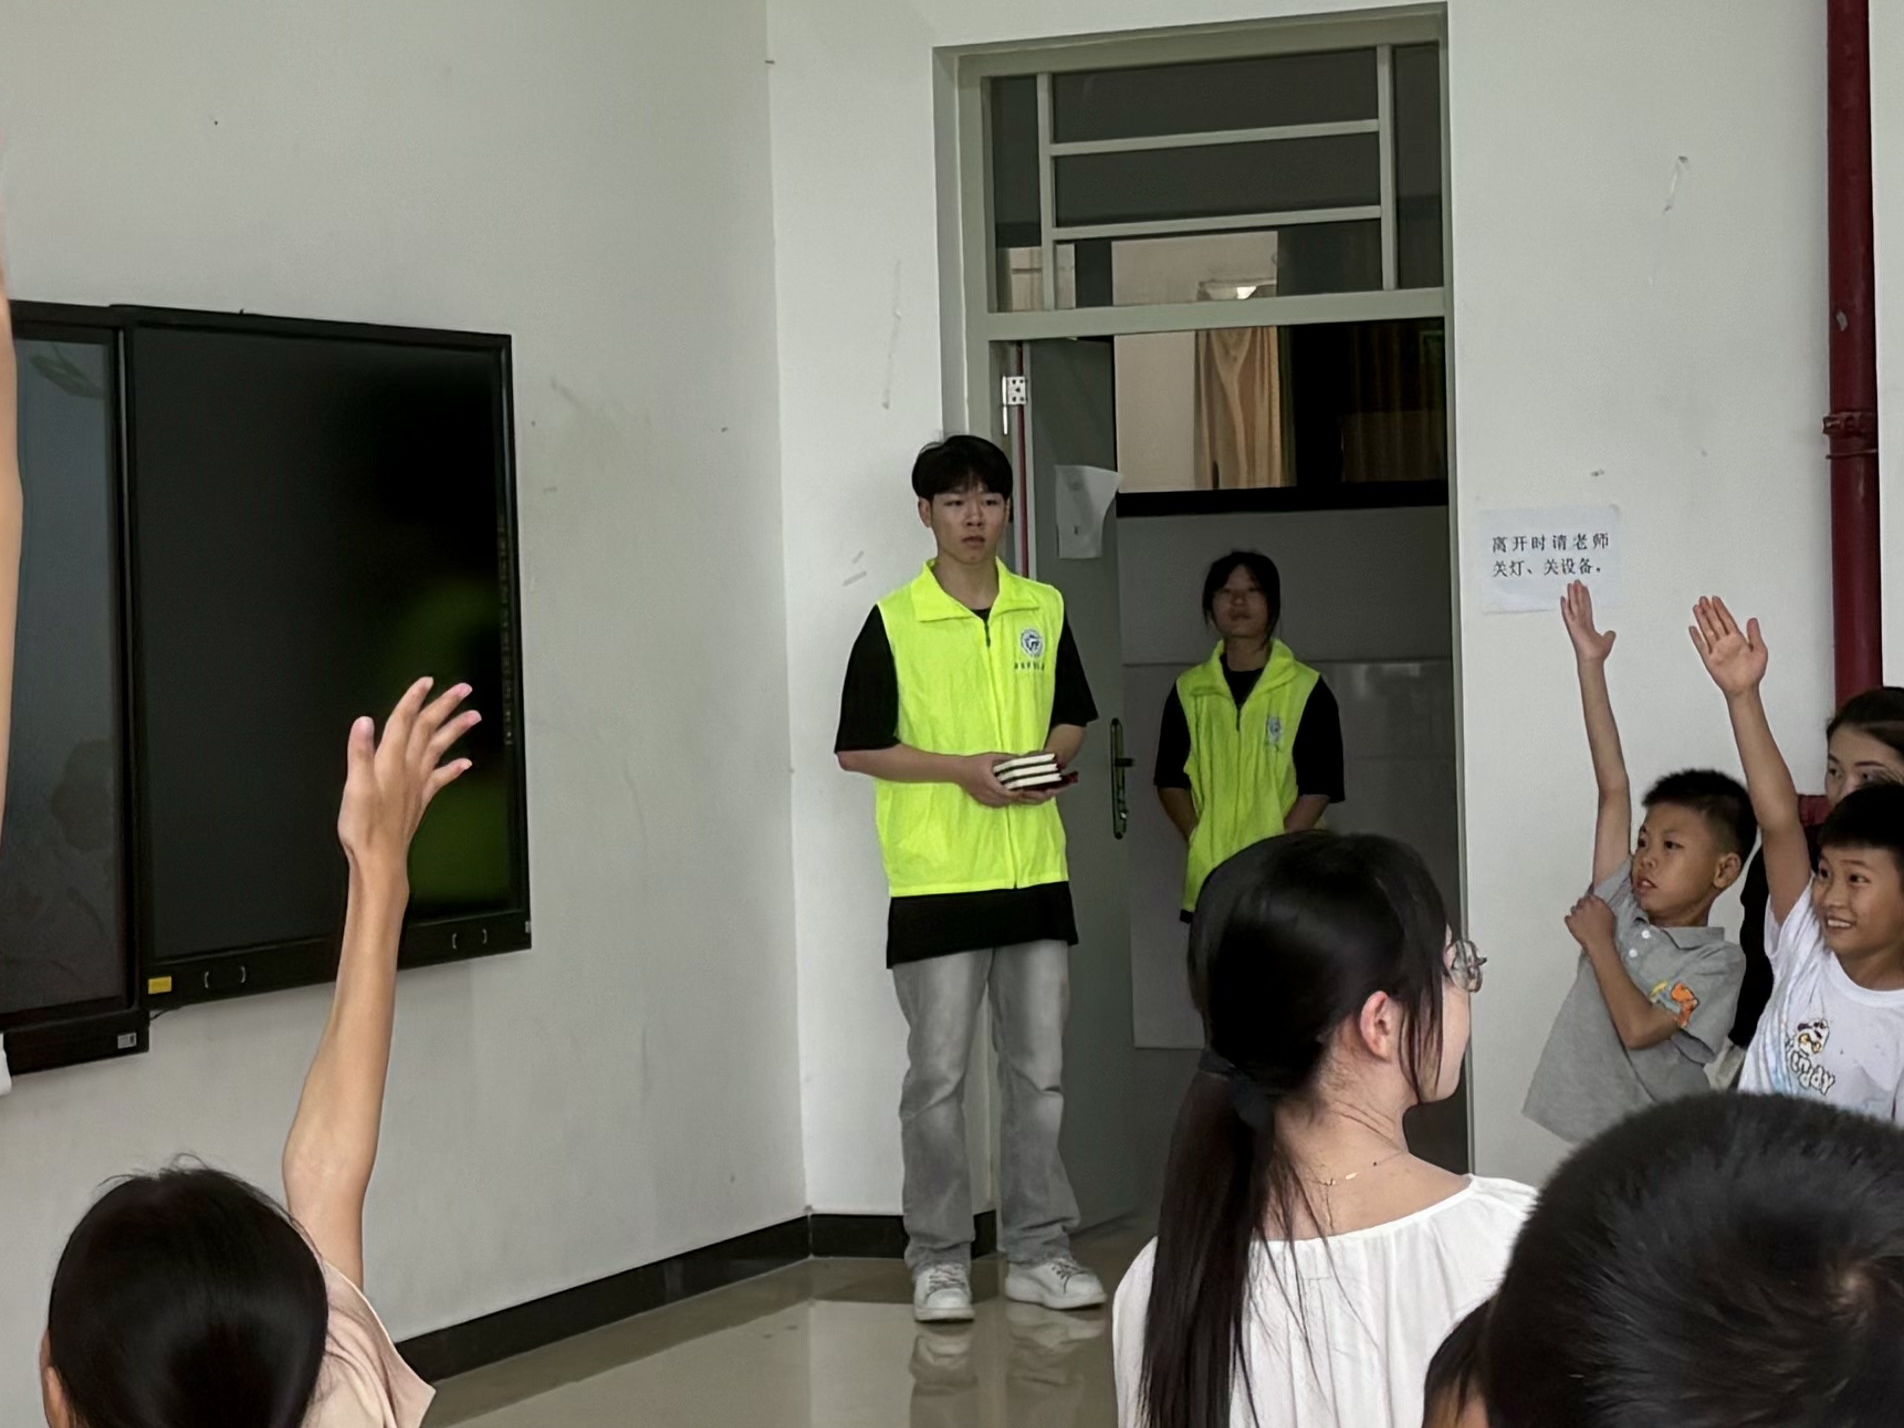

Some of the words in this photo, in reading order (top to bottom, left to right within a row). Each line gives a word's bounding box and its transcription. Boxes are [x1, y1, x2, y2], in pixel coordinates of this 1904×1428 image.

[1492, 532, 1609, 554] 离开时请老师
